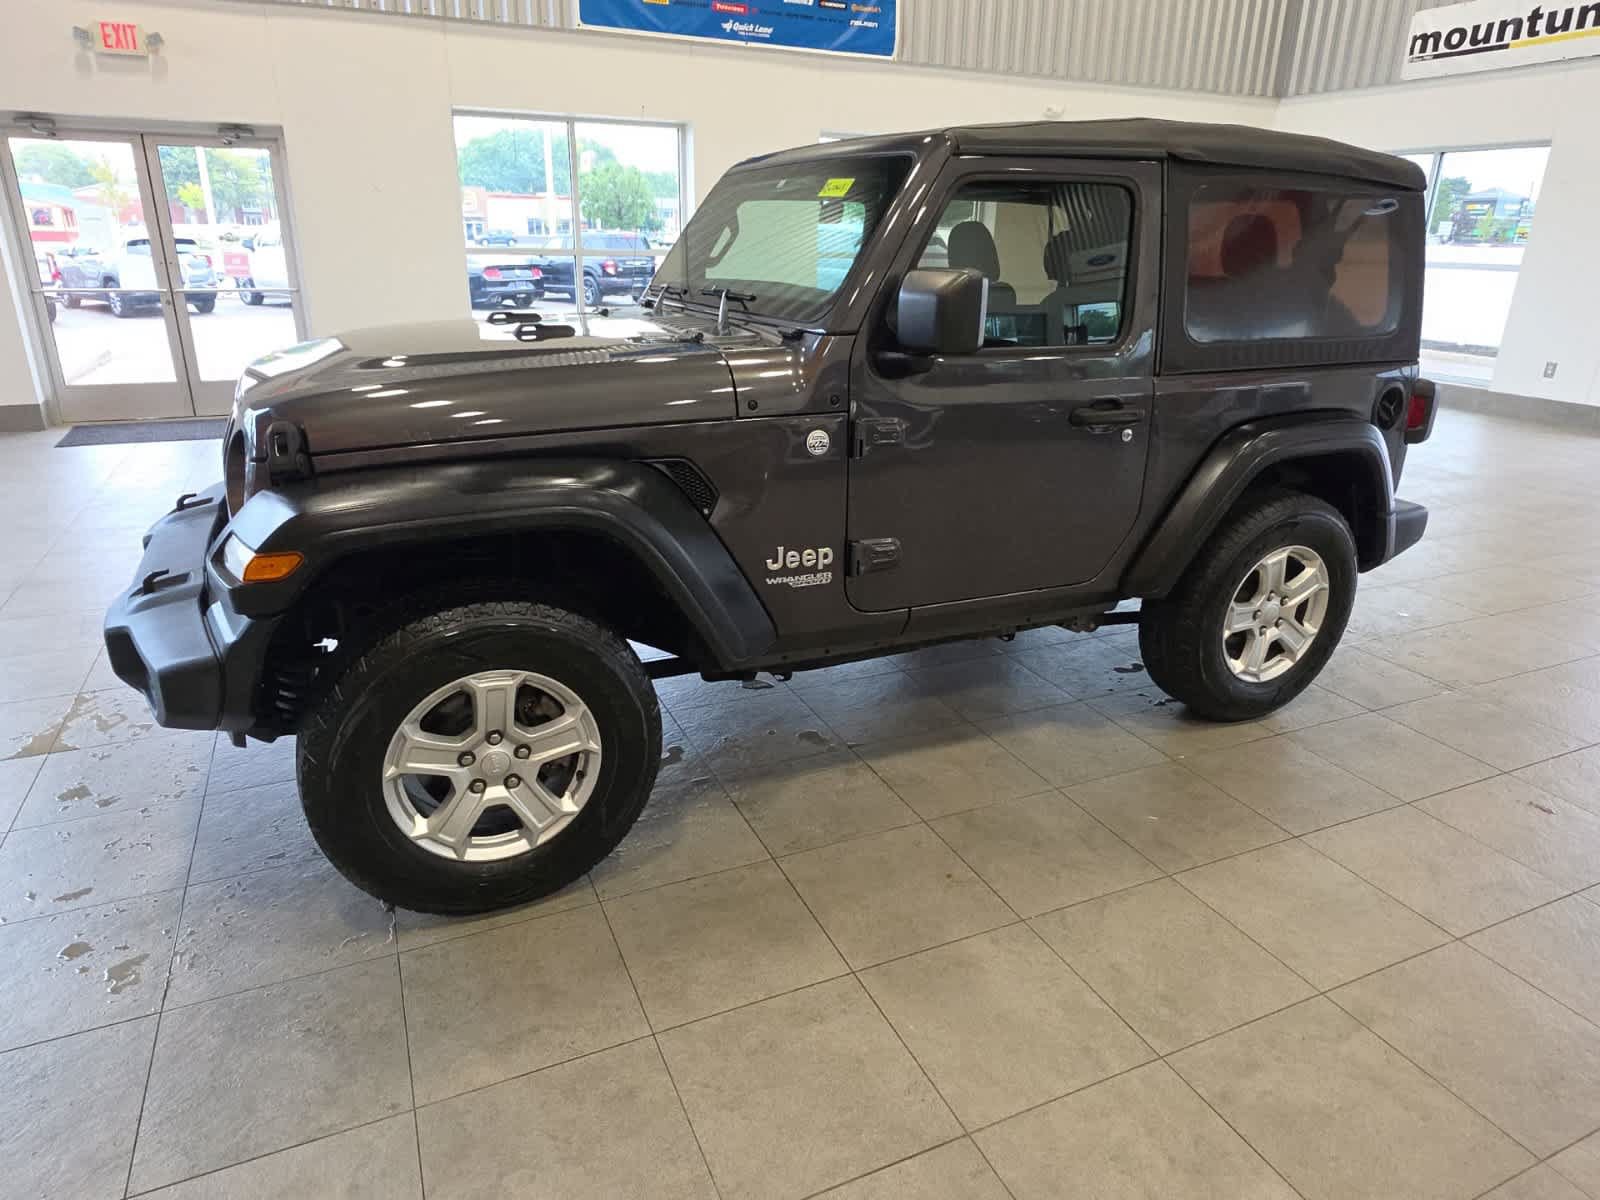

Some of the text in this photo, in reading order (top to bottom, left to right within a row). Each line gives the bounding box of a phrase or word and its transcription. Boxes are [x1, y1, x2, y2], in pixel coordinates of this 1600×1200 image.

[100, 21, 137, 50] EXIT
[733, 21, 774, 34] Quick Lane
[1409, 2, 1600, 56] mountun
[766, 546, 833, 570] Jeep
[765, 572, 832, 585] WRANGLER
